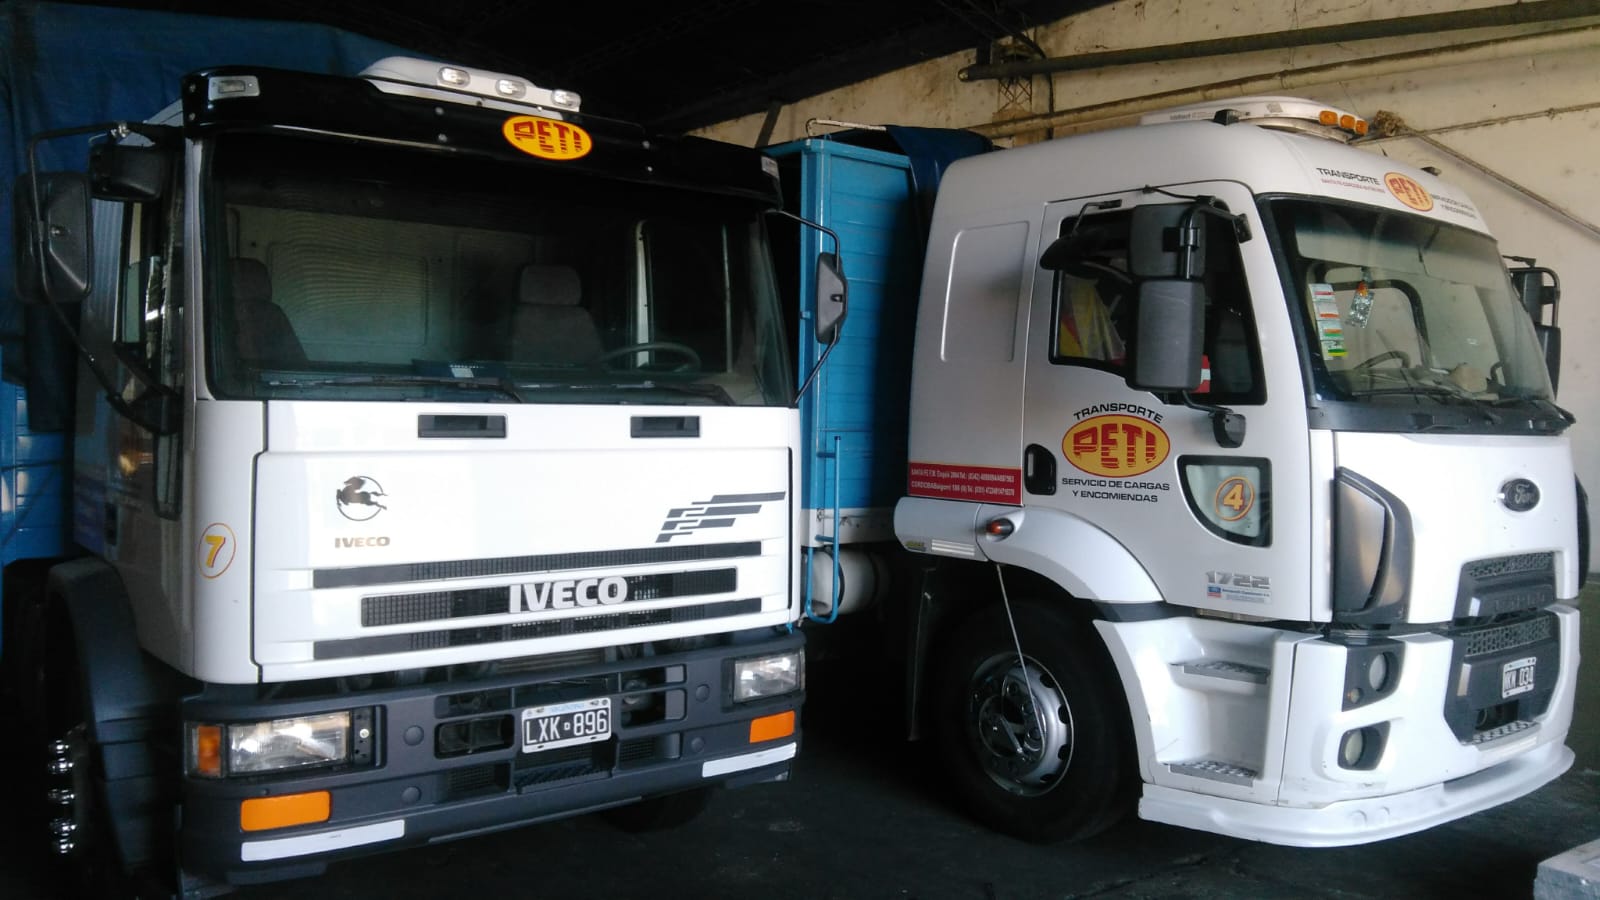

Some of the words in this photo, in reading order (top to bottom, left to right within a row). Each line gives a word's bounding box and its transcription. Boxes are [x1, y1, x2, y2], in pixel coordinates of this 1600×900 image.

[513, 121, 582, 154] PETI
[1316, 168, 1381, 186] TRANSPORTE
[1073, 402, 1164, 424] TRANSPORTE
[1073, 423, 1157, 469] PETI
[1061, 478, 1107, 488] SERVICIO
[1108, 480, 1123, 489] DE
[1124, 481, 1170, 491] CARGAS
[1080, 490, 1158, 502] ENCOMIENDAS
[1223, 482, 1246, 511] 4
[205, 535, 226, 568] 7
[334, 536, 391, 549] IVECO
[1206, 571, 1271, 590] 1722
[509, 576, 628, 614] IVECO
[526, 716, 561, 745] LXK
[573, 709, 608, 736] 896
